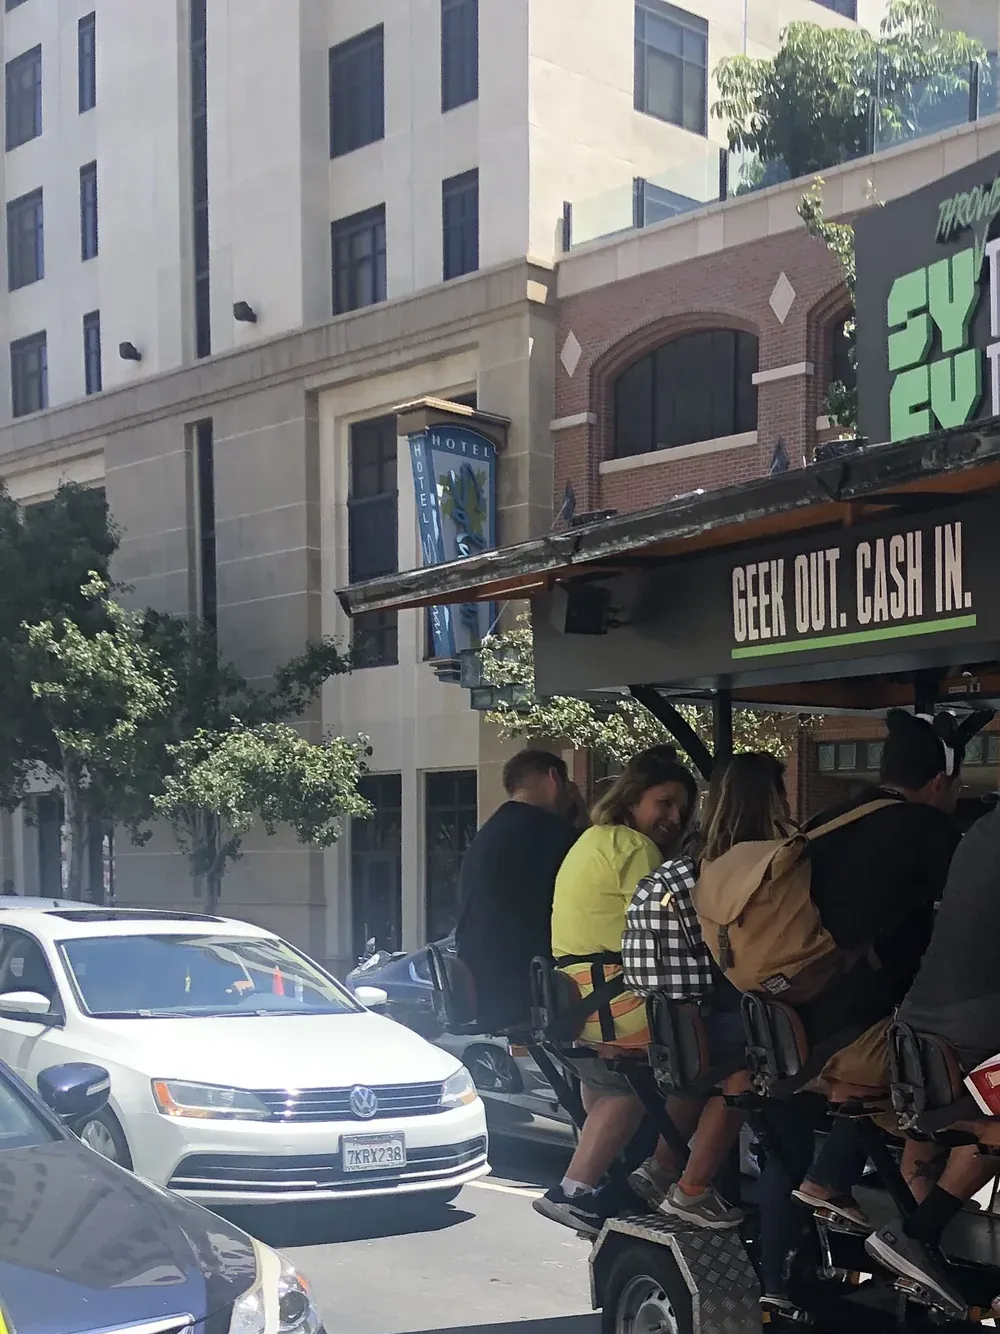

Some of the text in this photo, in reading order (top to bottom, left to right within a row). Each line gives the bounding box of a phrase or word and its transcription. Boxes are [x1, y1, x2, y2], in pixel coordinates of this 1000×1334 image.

[432, 434, 491, 458] HOTEL
[414, 442, 429, 524] HOTEL
[732, 521, 972, 642] GEEK OUT. CASH IN.
[347, 1146, 402, 1165] 7KRX238
